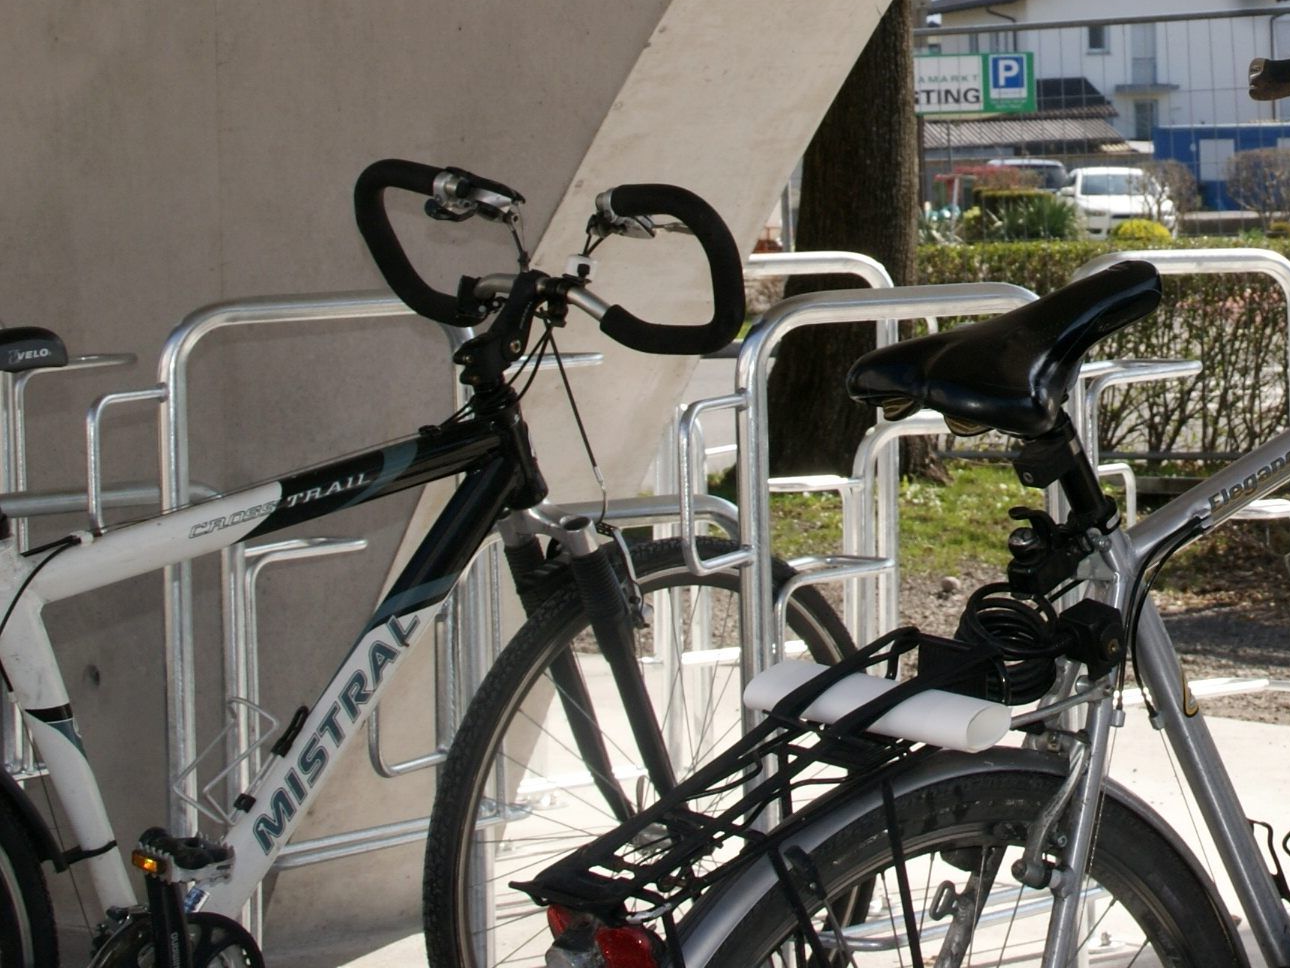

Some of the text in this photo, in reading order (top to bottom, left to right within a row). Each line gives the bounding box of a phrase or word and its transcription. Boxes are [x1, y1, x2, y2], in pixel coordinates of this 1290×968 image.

[999, 59, 1020, 87] P
[17, 348, 49, 360] VELO
[286, 473, 371, 508] TRAIL
[253, 614, 419, 855] MISTRAL
